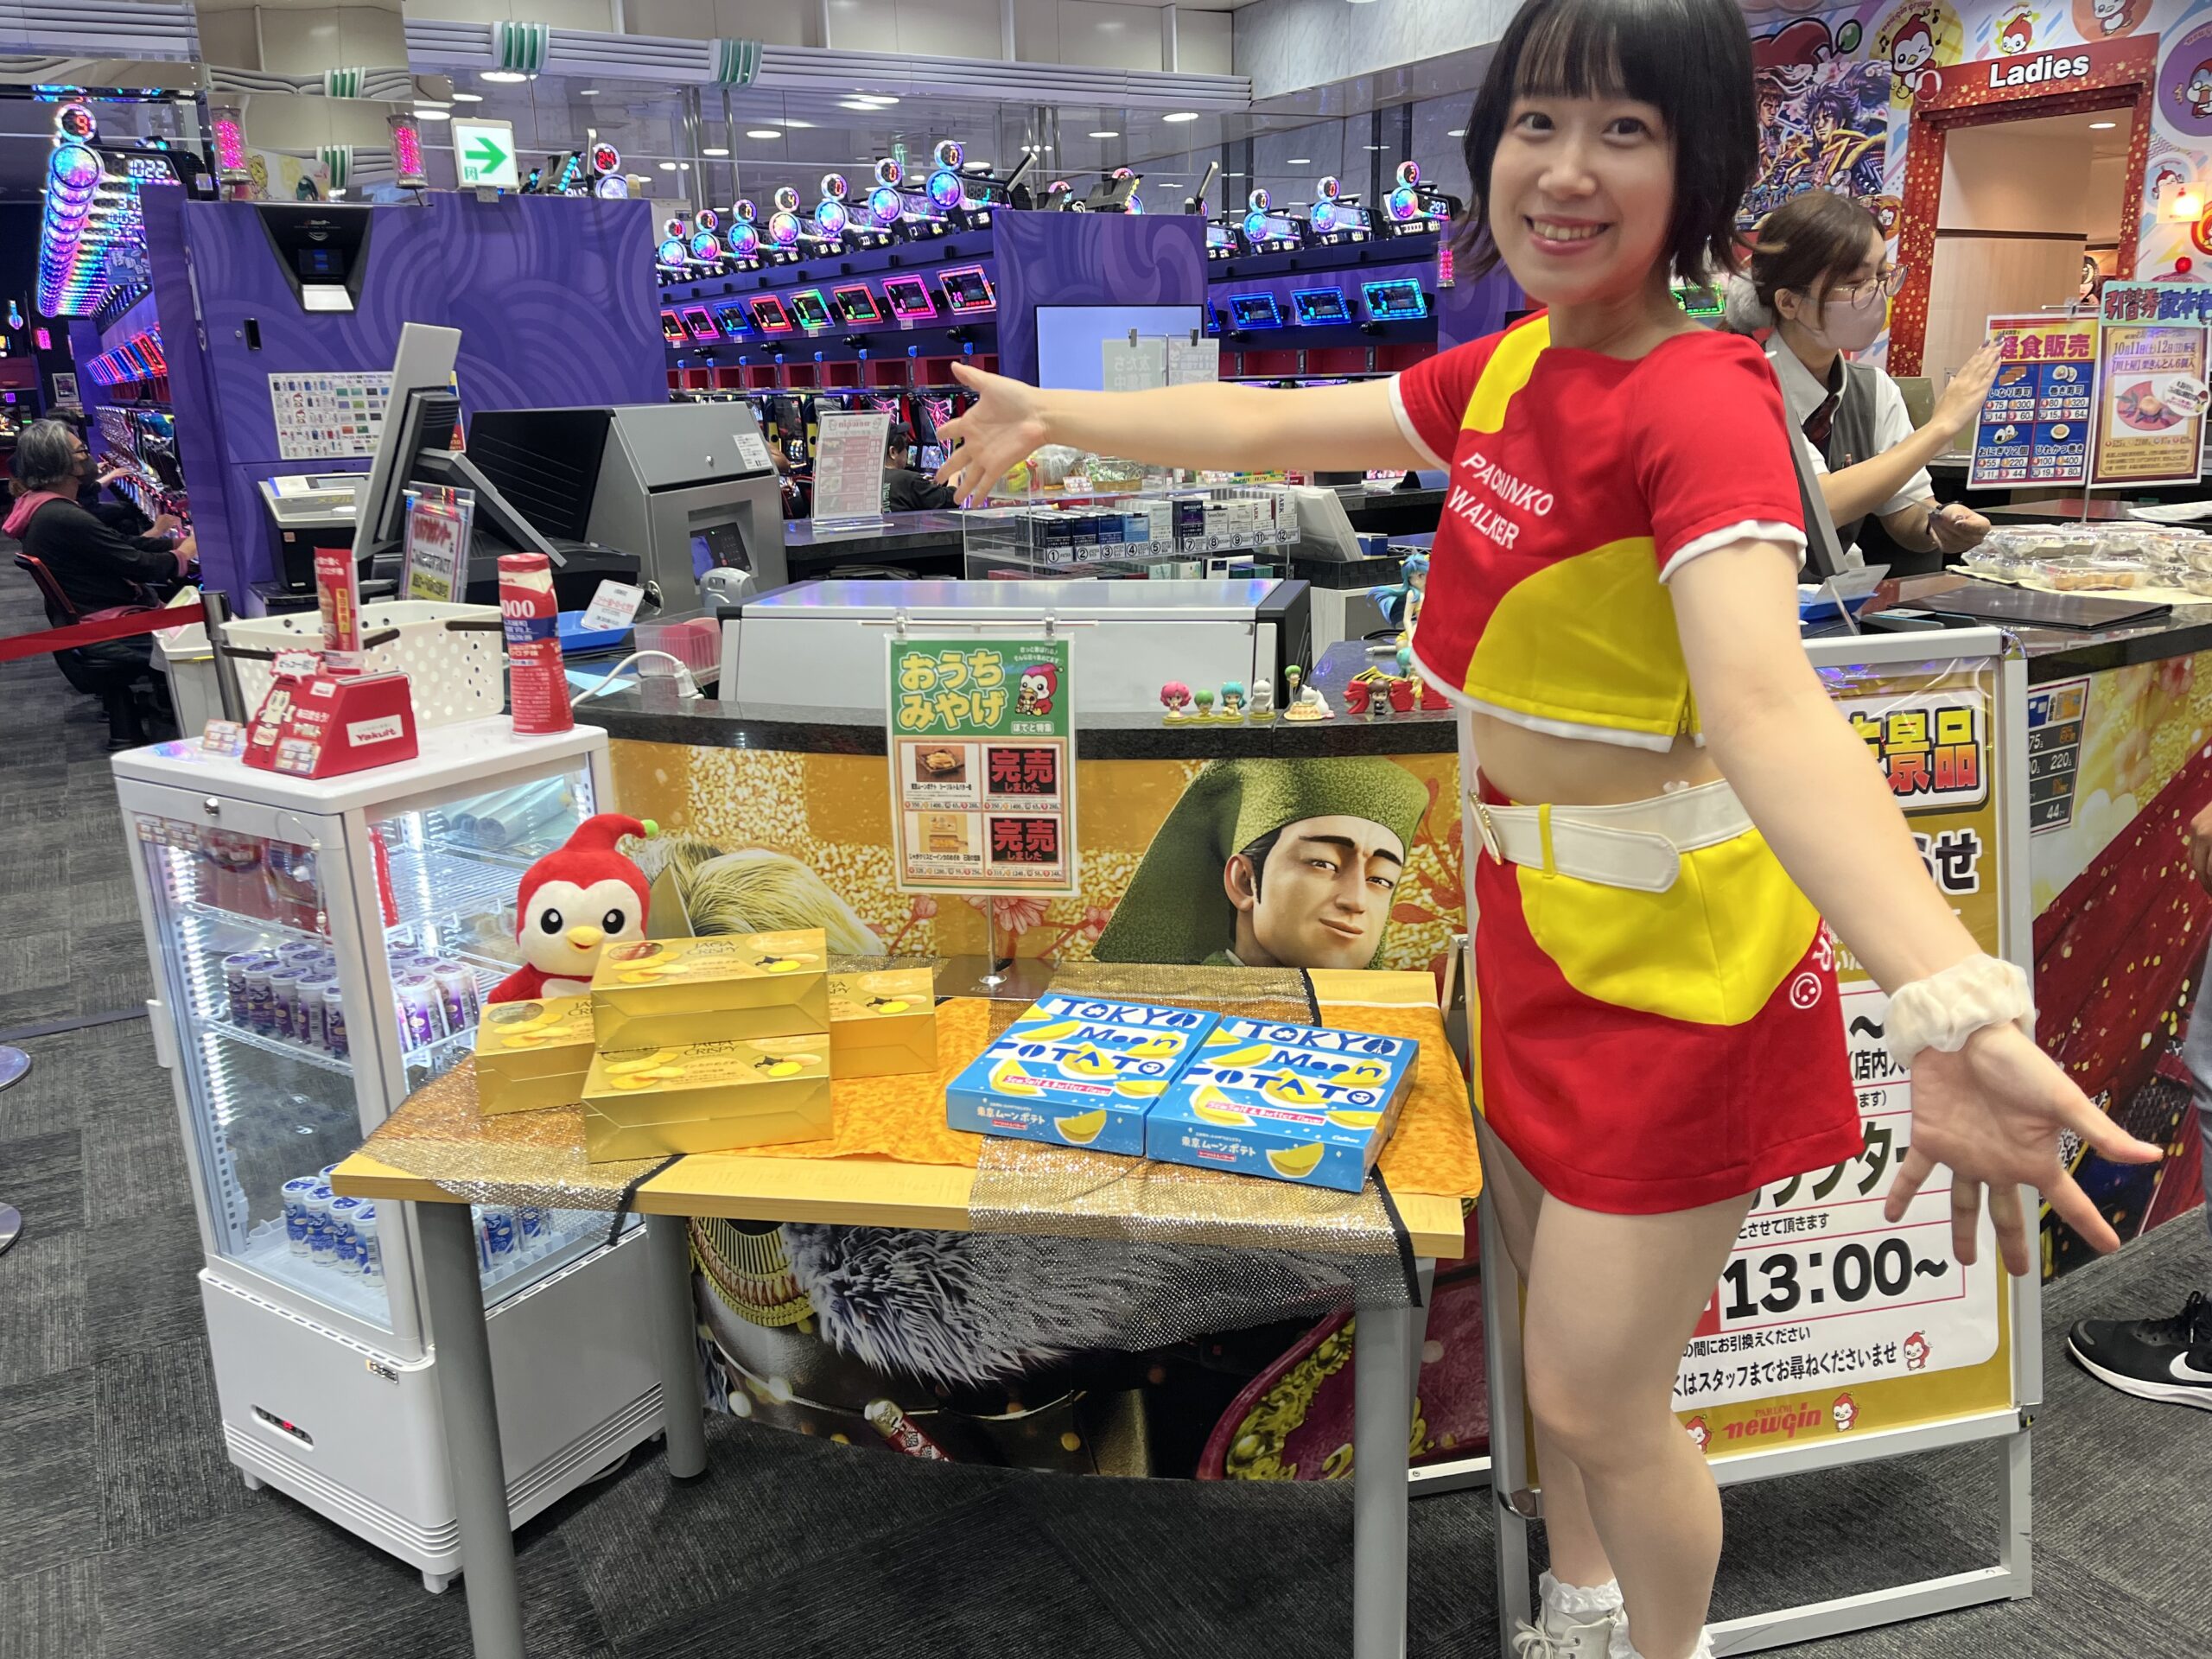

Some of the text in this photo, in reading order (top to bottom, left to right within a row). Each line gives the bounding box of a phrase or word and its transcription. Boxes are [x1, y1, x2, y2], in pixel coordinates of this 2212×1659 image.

[1990, 54, 2090, 89] Ladies
[130, 159, 167, 179] 1022
[2000, 334, 2090, 360] 軽食販売
[1989, 387, 2032, 397] いなり寿司
[2049, 385, 2085, 397] 巻き寿司
[1978, 445, 2029, 456] おにぎり2個
[2035, 444, 2084, 455] ひれかつ巻き
[1447, 485, 1520, 550] WALKER
[900, 650, 1004, 690] おうち
[899, 691, 1007, 730] みやげ
[355, 728, 397, 741] Yakult
[991, 749, 1053, 784] 完売
[1004, 783, 1040, 792] しました
[994, 820, 1055, 852] 完売
[1007, 851, 1043, 861] しました
[1915, 833, 1979, 890] せ
[687, 946, 739, 956] CRISPY
[1059, 999, 1198, 1028] TOKYO
[1074, 1026, 1179, 1049] Moon
[1245, 1020, 1396, 1055] TOKYO
[684, 1046, 739, 1056] CRISPY
[987, 1041, 1166, 1076] POTATO
[1271, 1050, 1383, 1078] Moon
[1181, 1067, 1376, 1106] POTATO
[1856, 1090, 1887, 1108] ます)
[976, 1105, 1046, 1124] 東京ムーンポテト
[1181, 1135, 1256, 1157] 東京ムーンポテト
[1722, 1402, 1822, 1439] newgin
